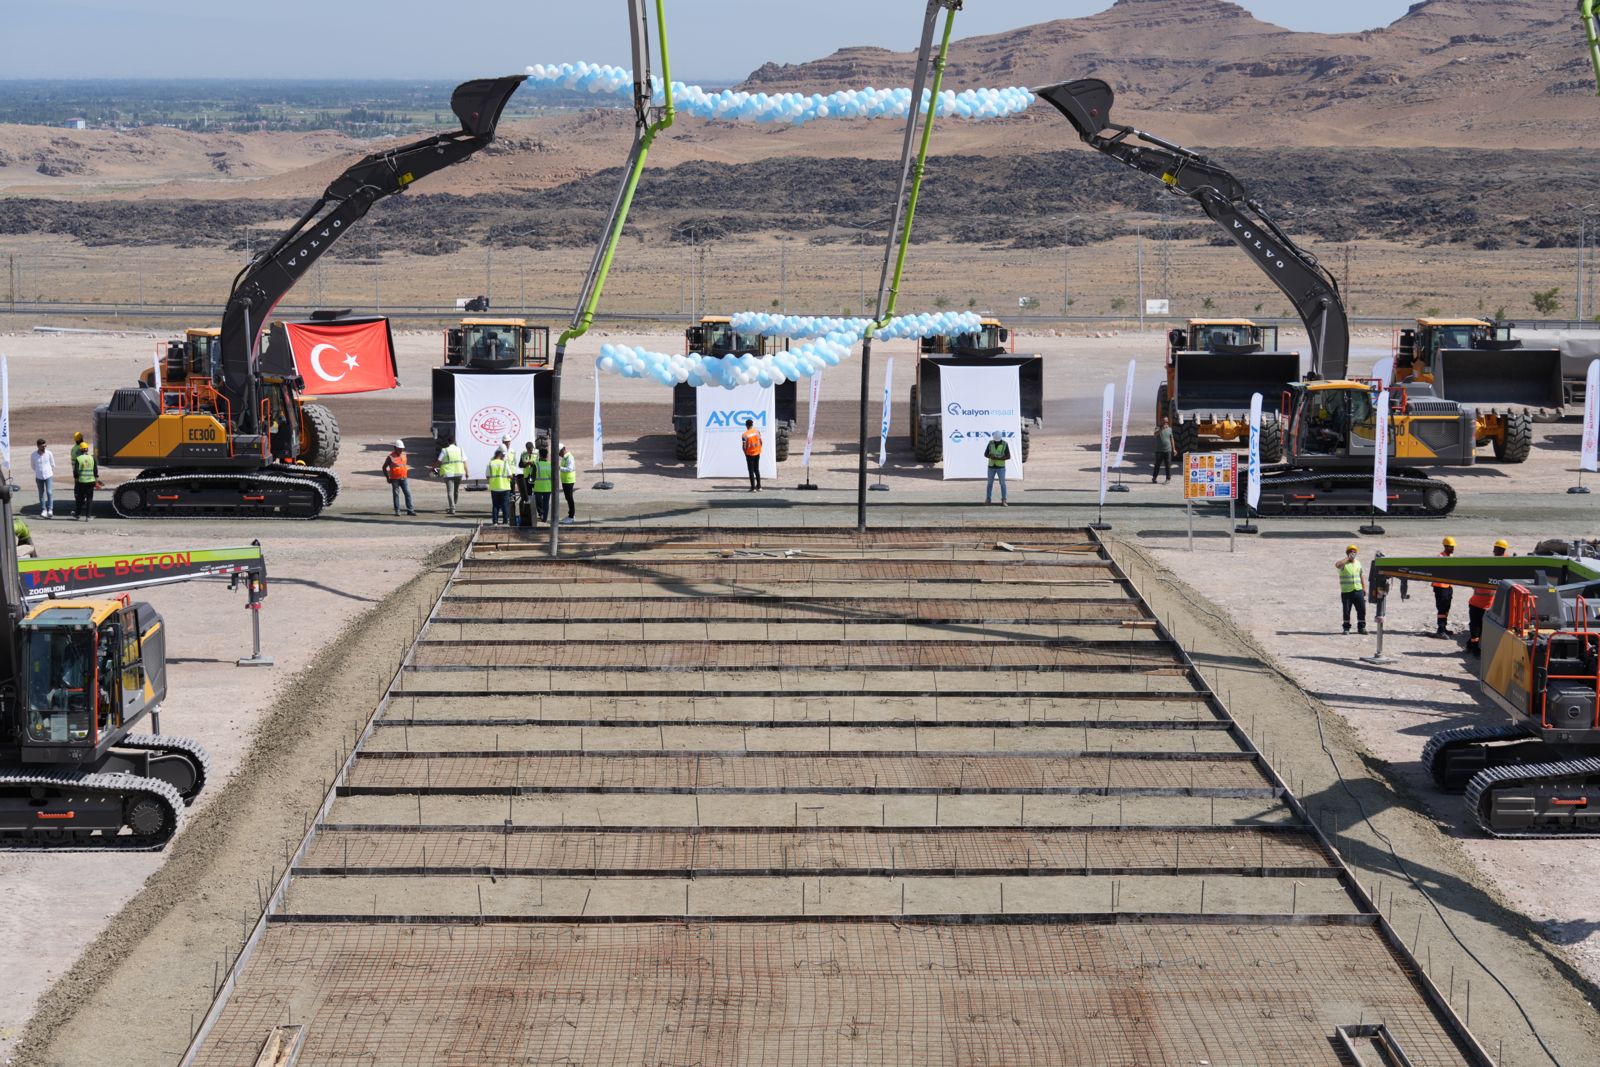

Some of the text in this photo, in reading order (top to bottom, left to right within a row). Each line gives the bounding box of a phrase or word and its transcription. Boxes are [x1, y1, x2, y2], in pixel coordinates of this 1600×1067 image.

[287, 220, 342, 266] VOLVO
[1233, 220, 1285, 268] VOLVO
[705, 410, 767, 427] AYGM
[189, 429, 216, 441] EC300
[114, 551, 191, 577] BETON
[28, 585, 66, 596] ZOOMLION
